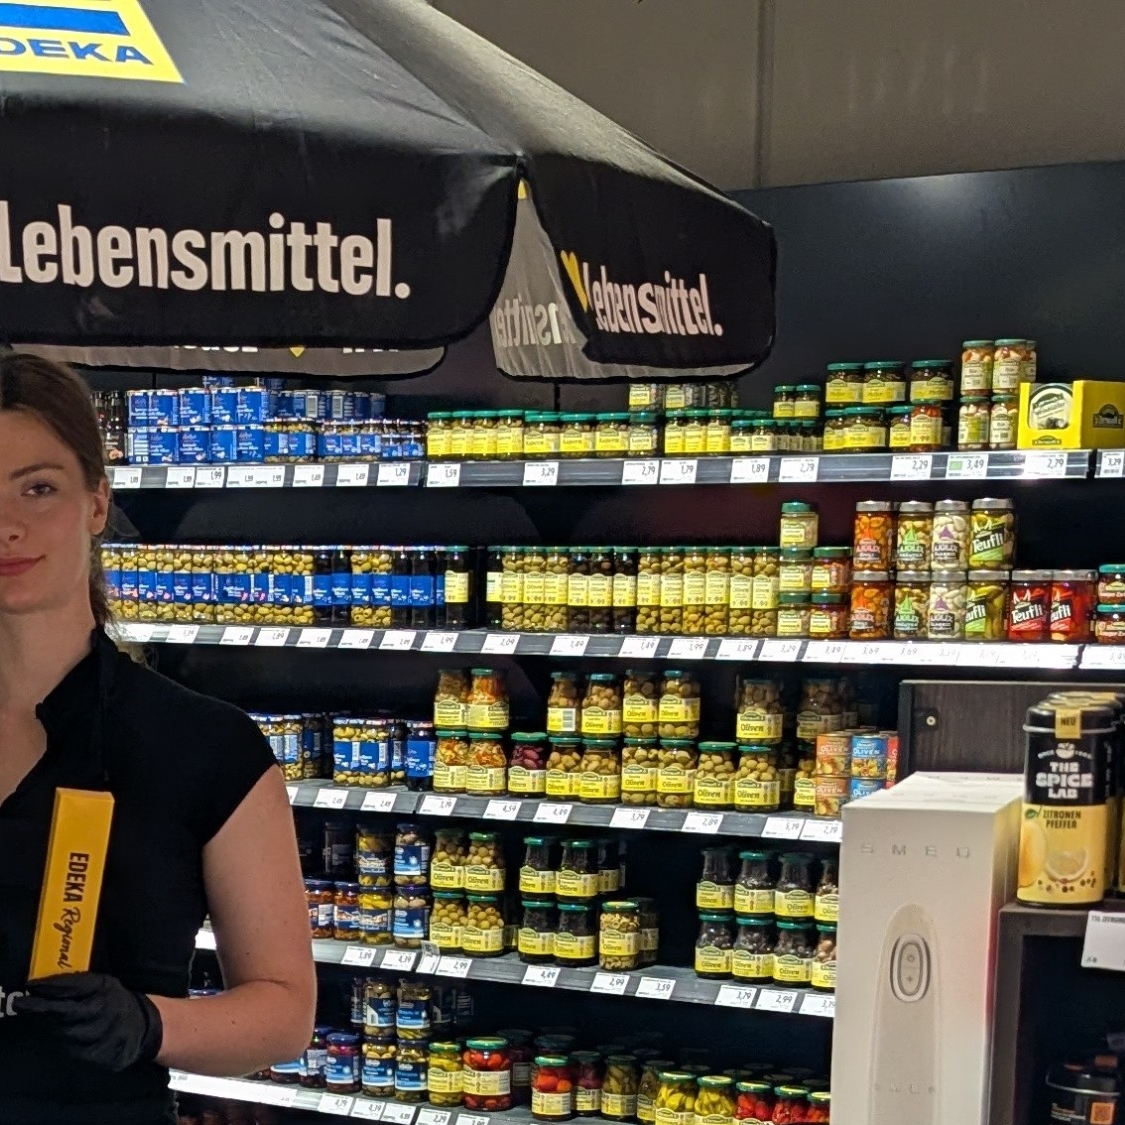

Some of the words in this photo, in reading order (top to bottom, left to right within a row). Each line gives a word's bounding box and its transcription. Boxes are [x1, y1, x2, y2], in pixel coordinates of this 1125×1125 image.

[971, 532, 1004, 554] Teufli
[964, 604, 987, 622] eufli
[1011, 604, 1044, 624] Teufli
[1050, 604, 1071, 621] eufli
[1060, 717, 1077, 726] NEU
[1049, 761, 1080, 773] THE
[1035, 772, 1094, 788] SPICE
[1047, 788, 1078, 799] LAB
[1042, 809, 1082, 819] ZITRONEN
[1045, 819, 1078, 829] PFEFFER
[62, 851, 90, 903] EDEKA
[50, 906, 81, 970] Regional
